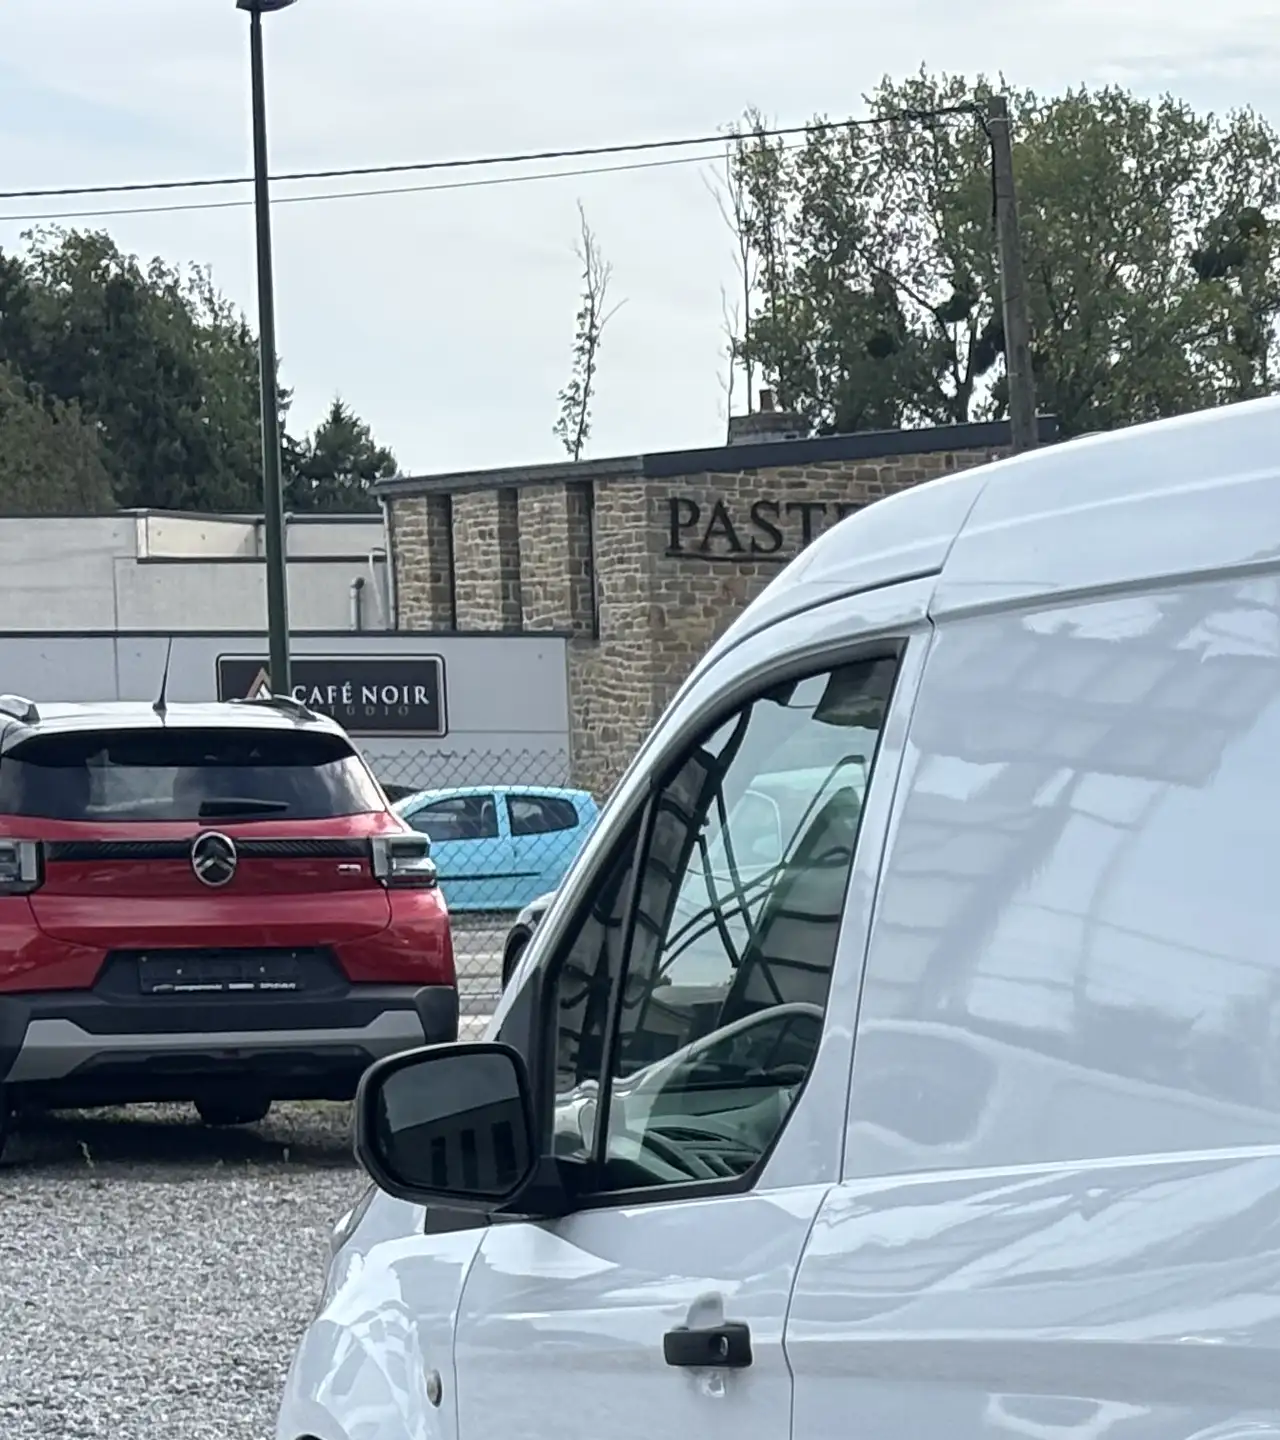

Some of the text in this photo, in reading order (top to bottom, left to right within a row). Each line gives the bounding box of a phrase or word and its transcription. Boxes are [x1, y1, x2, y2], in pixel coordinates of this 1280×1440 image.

[664, 496, 867, 554] PAST
[291, 680, 430, 706] CAFÉ NOIR
